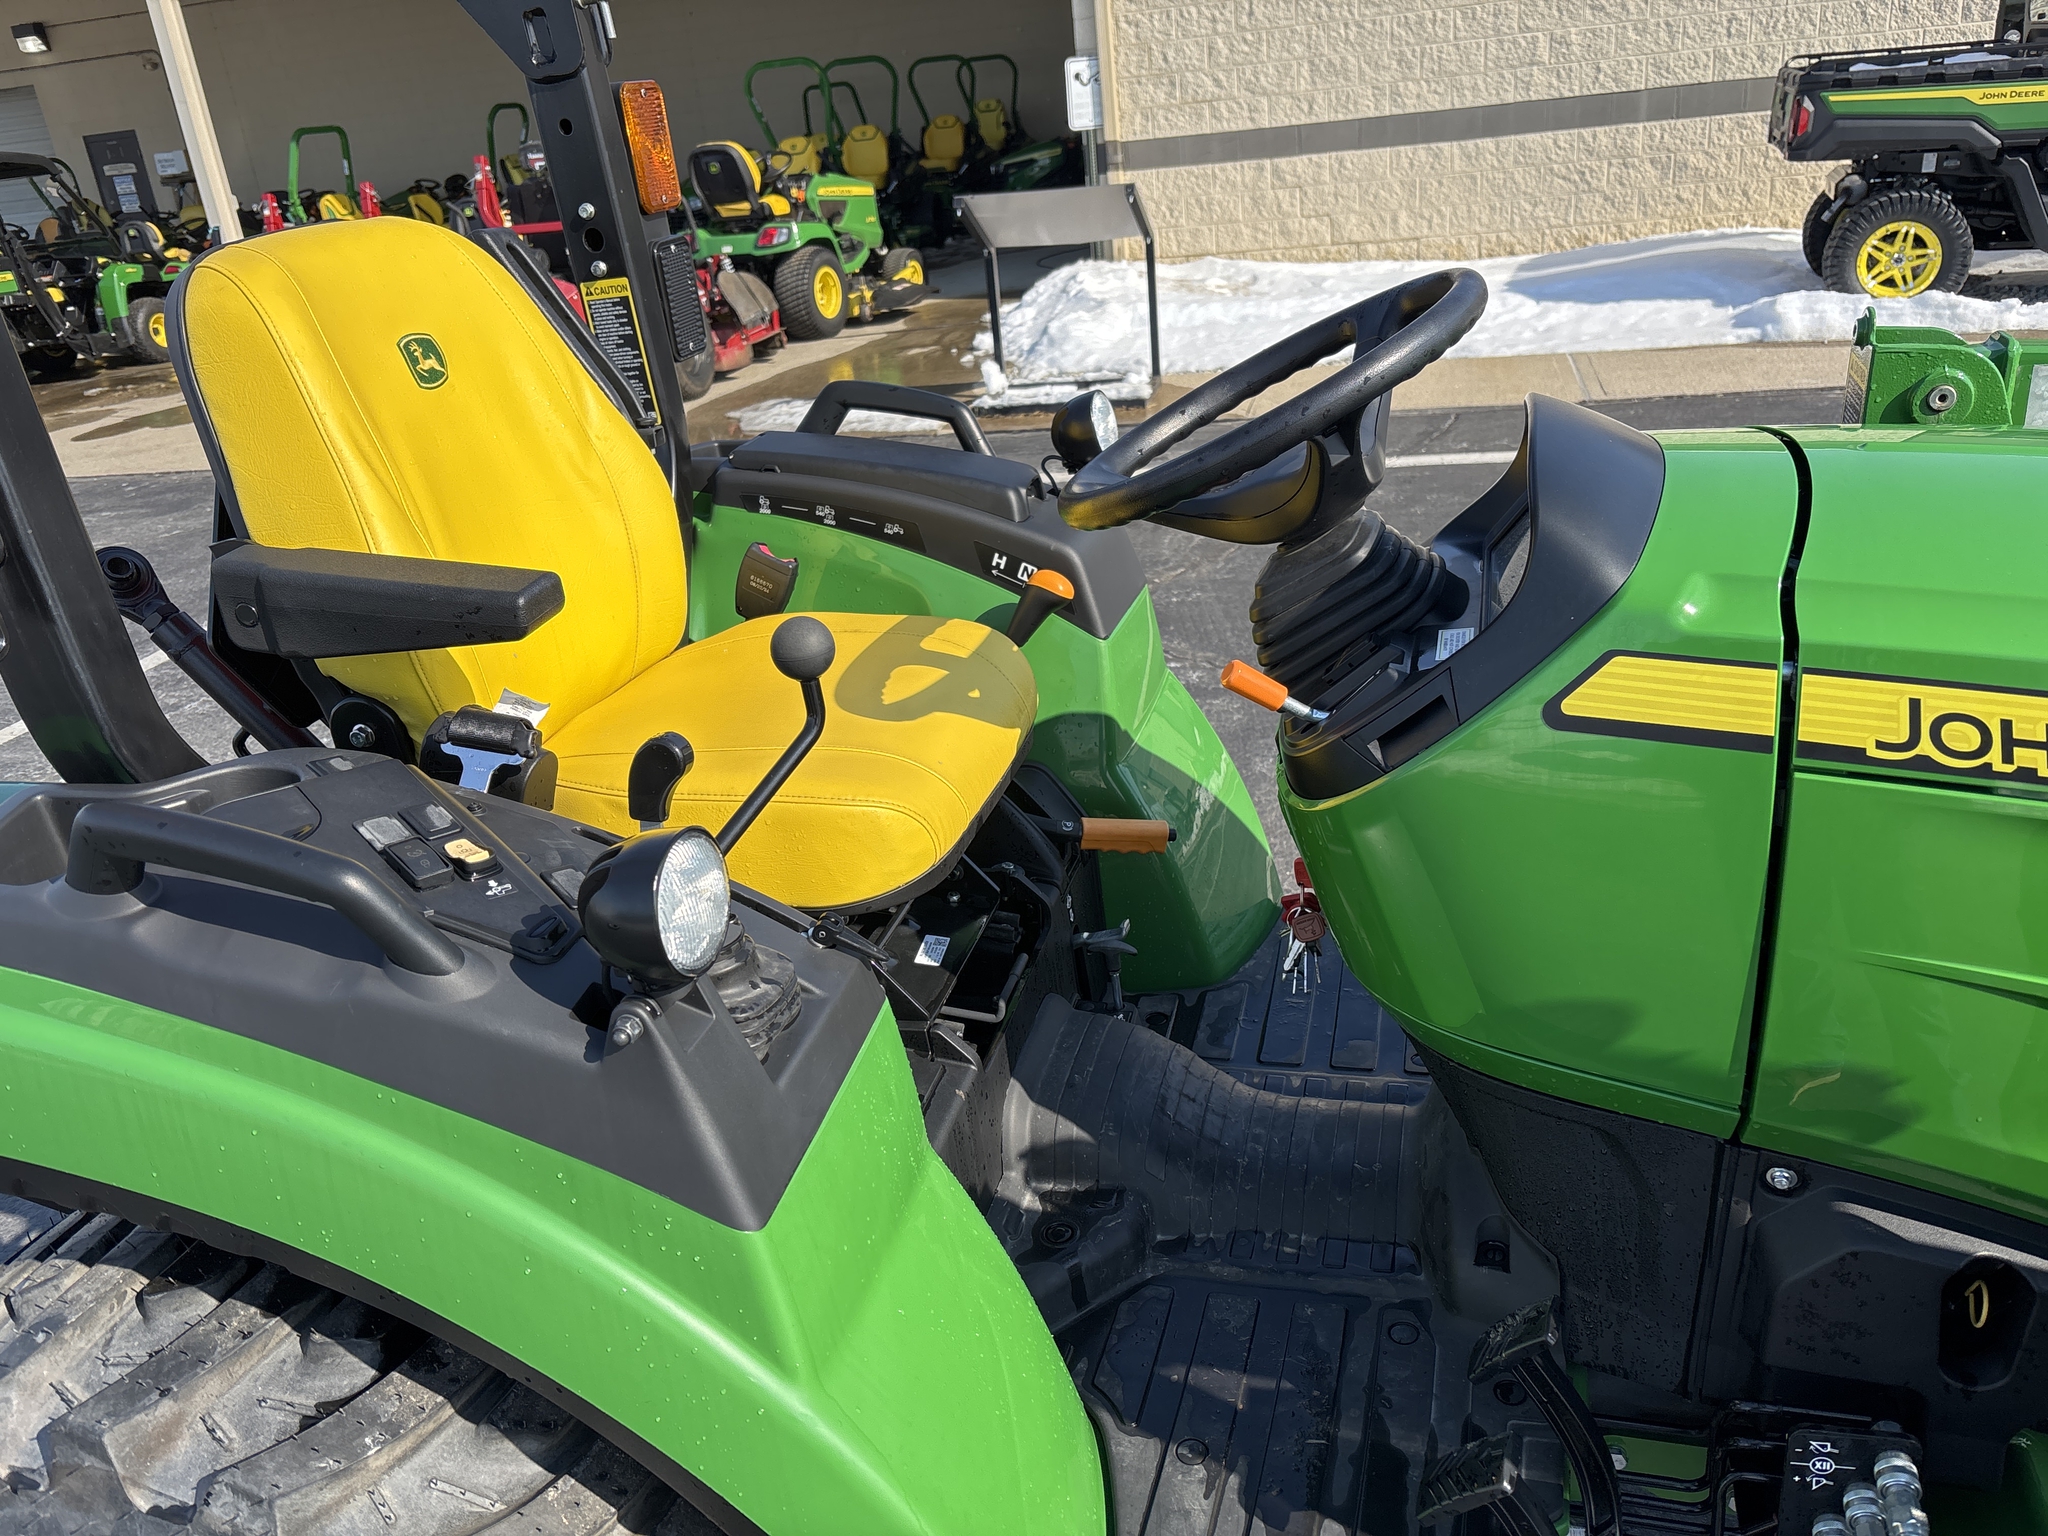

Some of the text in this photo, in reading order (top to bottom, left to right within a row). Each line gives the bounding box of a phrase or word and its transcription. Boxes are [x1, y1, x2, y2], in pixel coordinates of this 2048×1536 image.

[1979, 90, 2046, 101] JOHN DEERE
[593, 283, 629, 296] CAUTION
[823, 518, 836, 526] 2000
[884, 527, 894, 535] 540
[991, 552, 1035, 581] H N
[1814, 1460, 1831, 1471] XII
